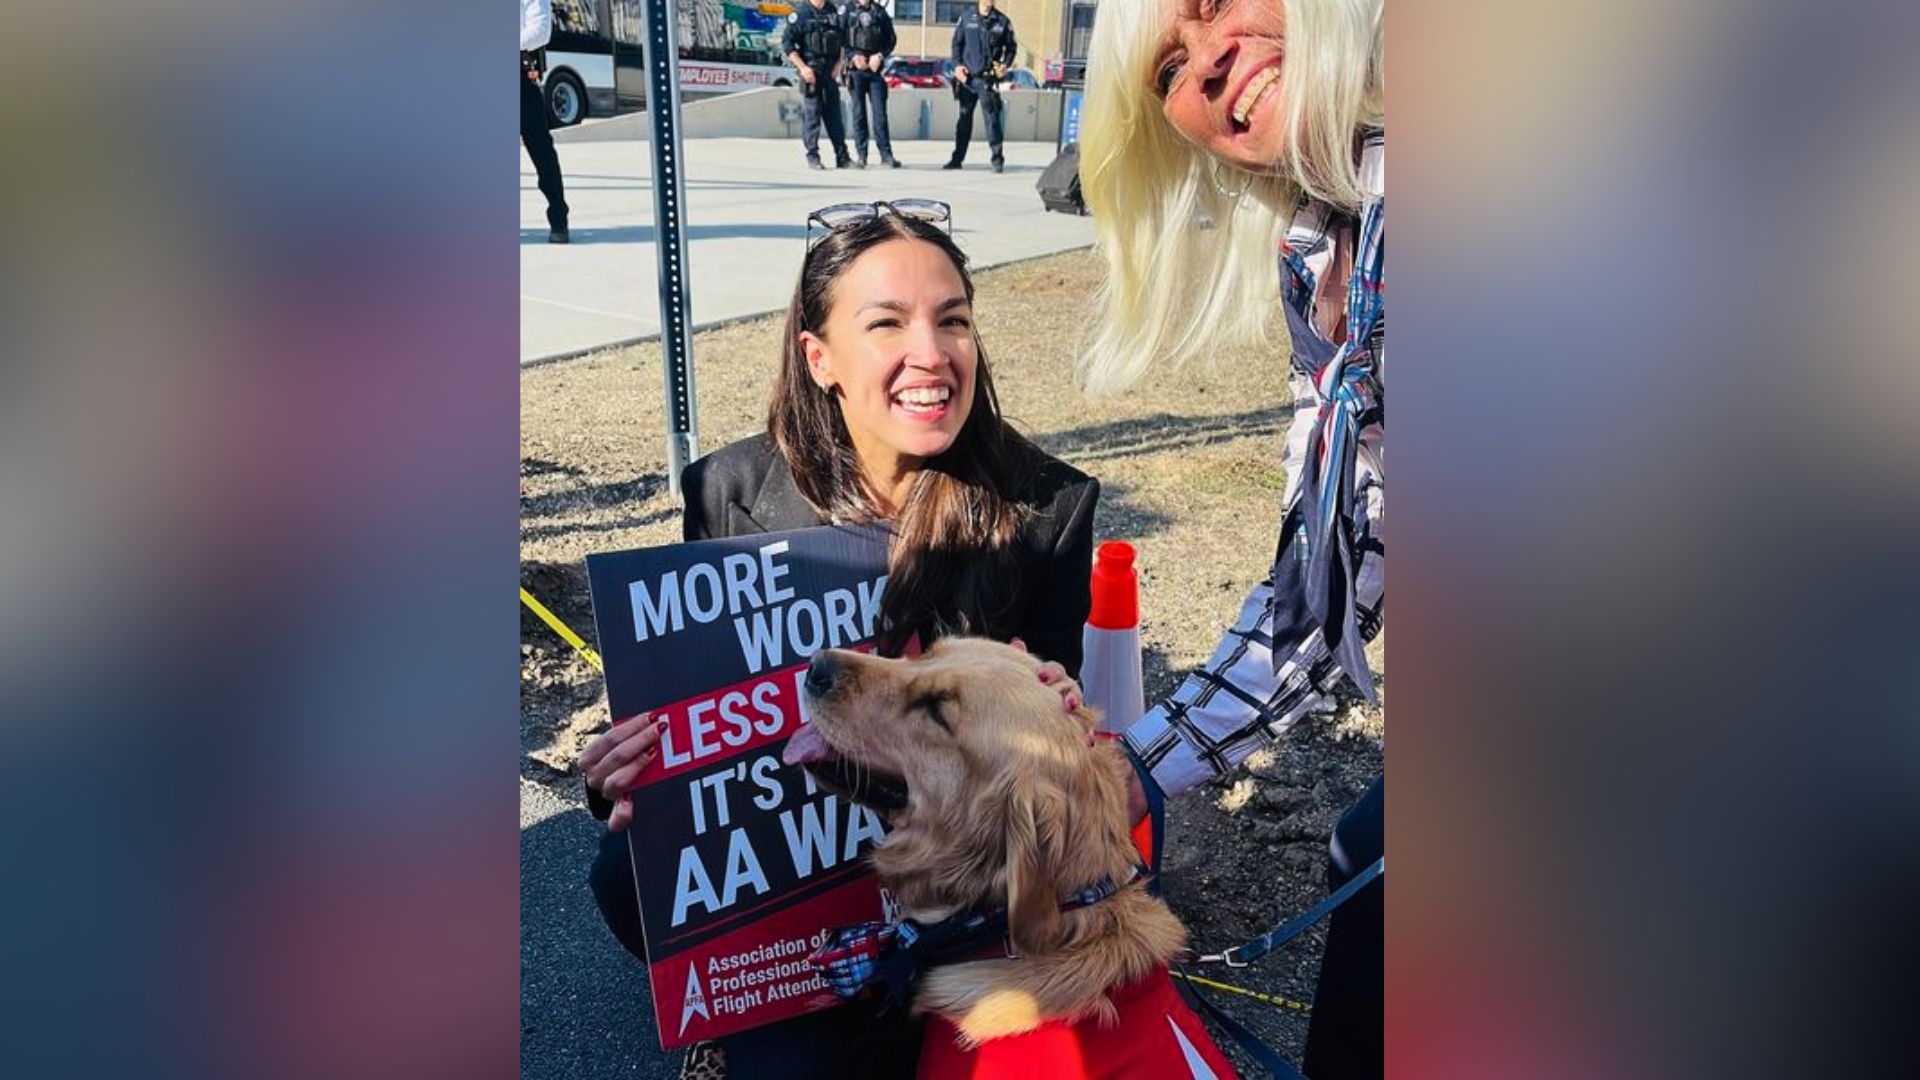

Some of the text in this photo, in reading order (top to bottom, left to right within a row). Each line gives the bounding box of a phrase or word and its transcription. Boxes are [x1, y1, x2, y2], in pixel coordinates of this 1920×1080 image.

[679, 67, 771, 85] MPLOYEE SHUTTLE
[629, 540, 796, 642] MORE
[658, 681, 784, 769] LESS
[689, 755, 784, 835] IT'S
[671, 794, 888, 927] AA WA
[708, 928, 828, 974] Association of
[710, 959, 811, 994] Professiona
[713, 973, 830, 1017] Flight Attenda
